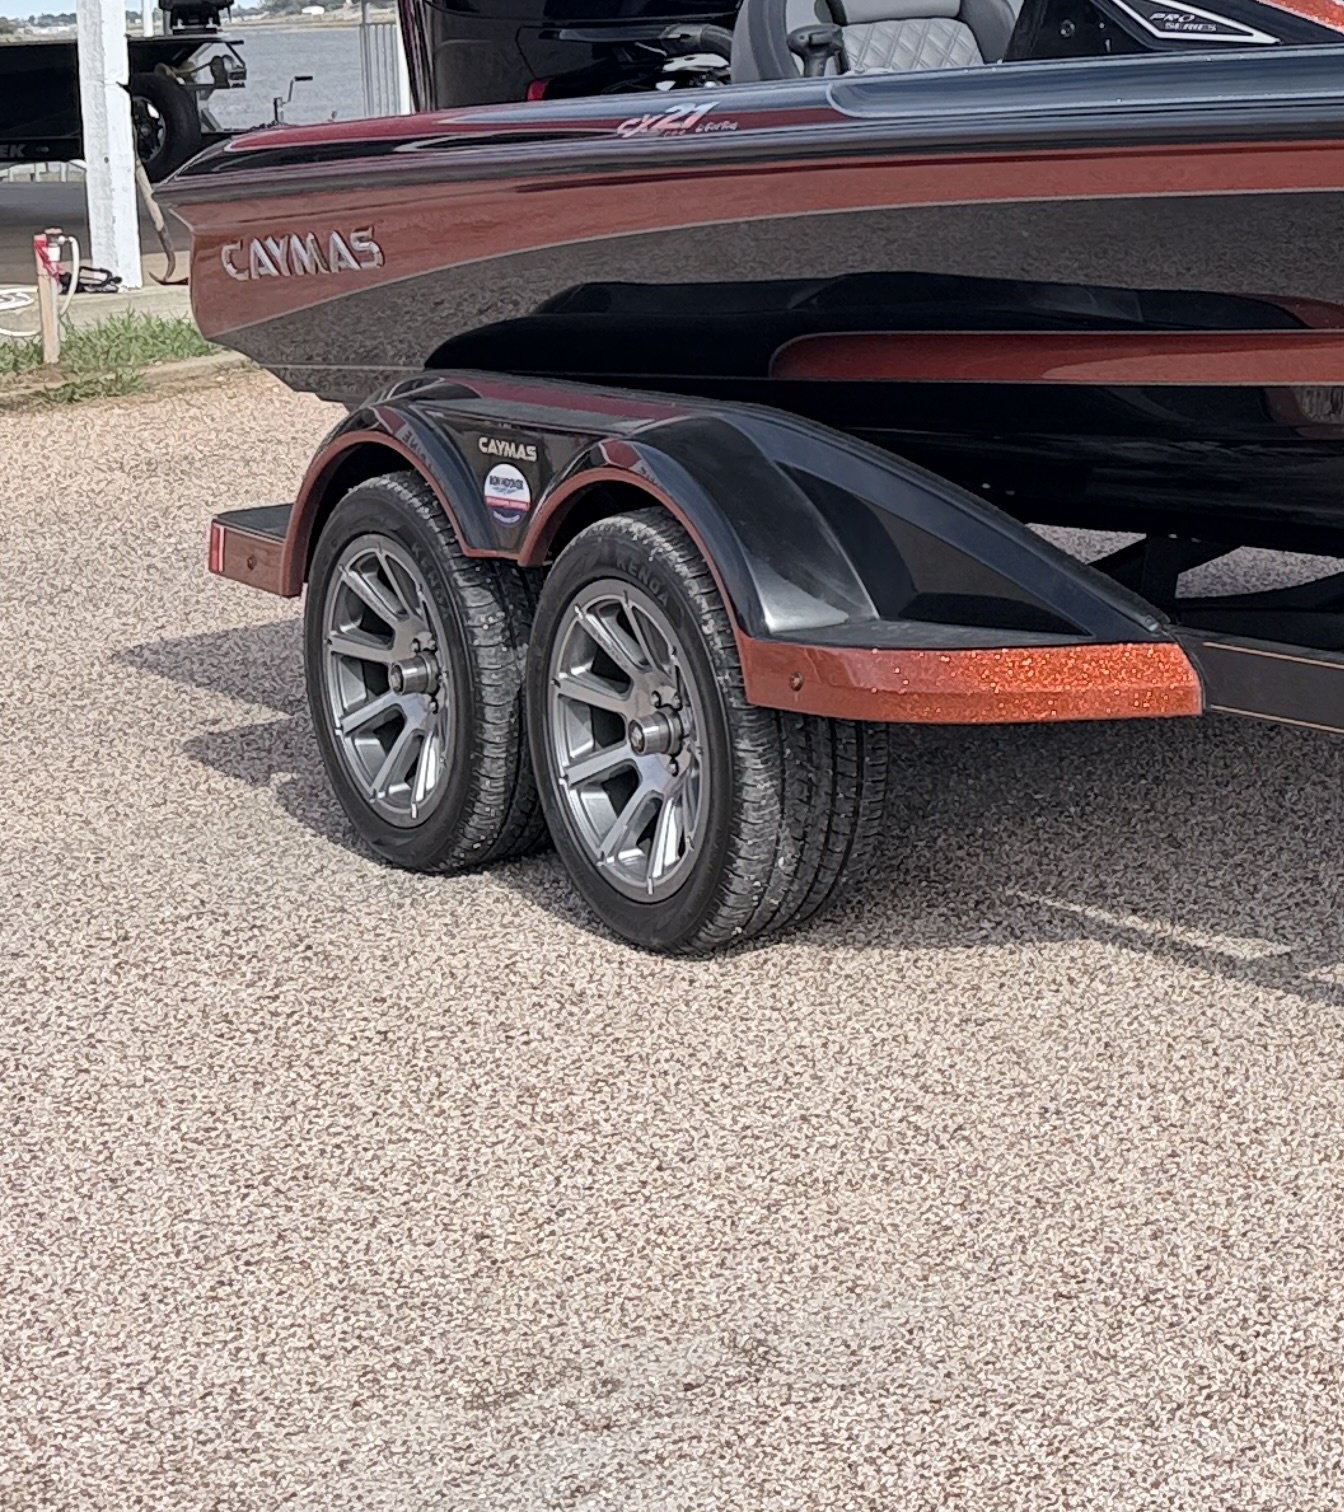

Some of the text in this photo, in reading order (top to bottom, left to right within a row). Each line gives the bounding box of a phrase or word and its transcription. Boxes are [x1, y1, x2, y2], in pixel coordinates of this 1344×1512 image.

[220, 224, 385, 281] CAYMAS
[478, 436, 538, 462] CAYMAS
[616, 553, 669, 606] KENDA
